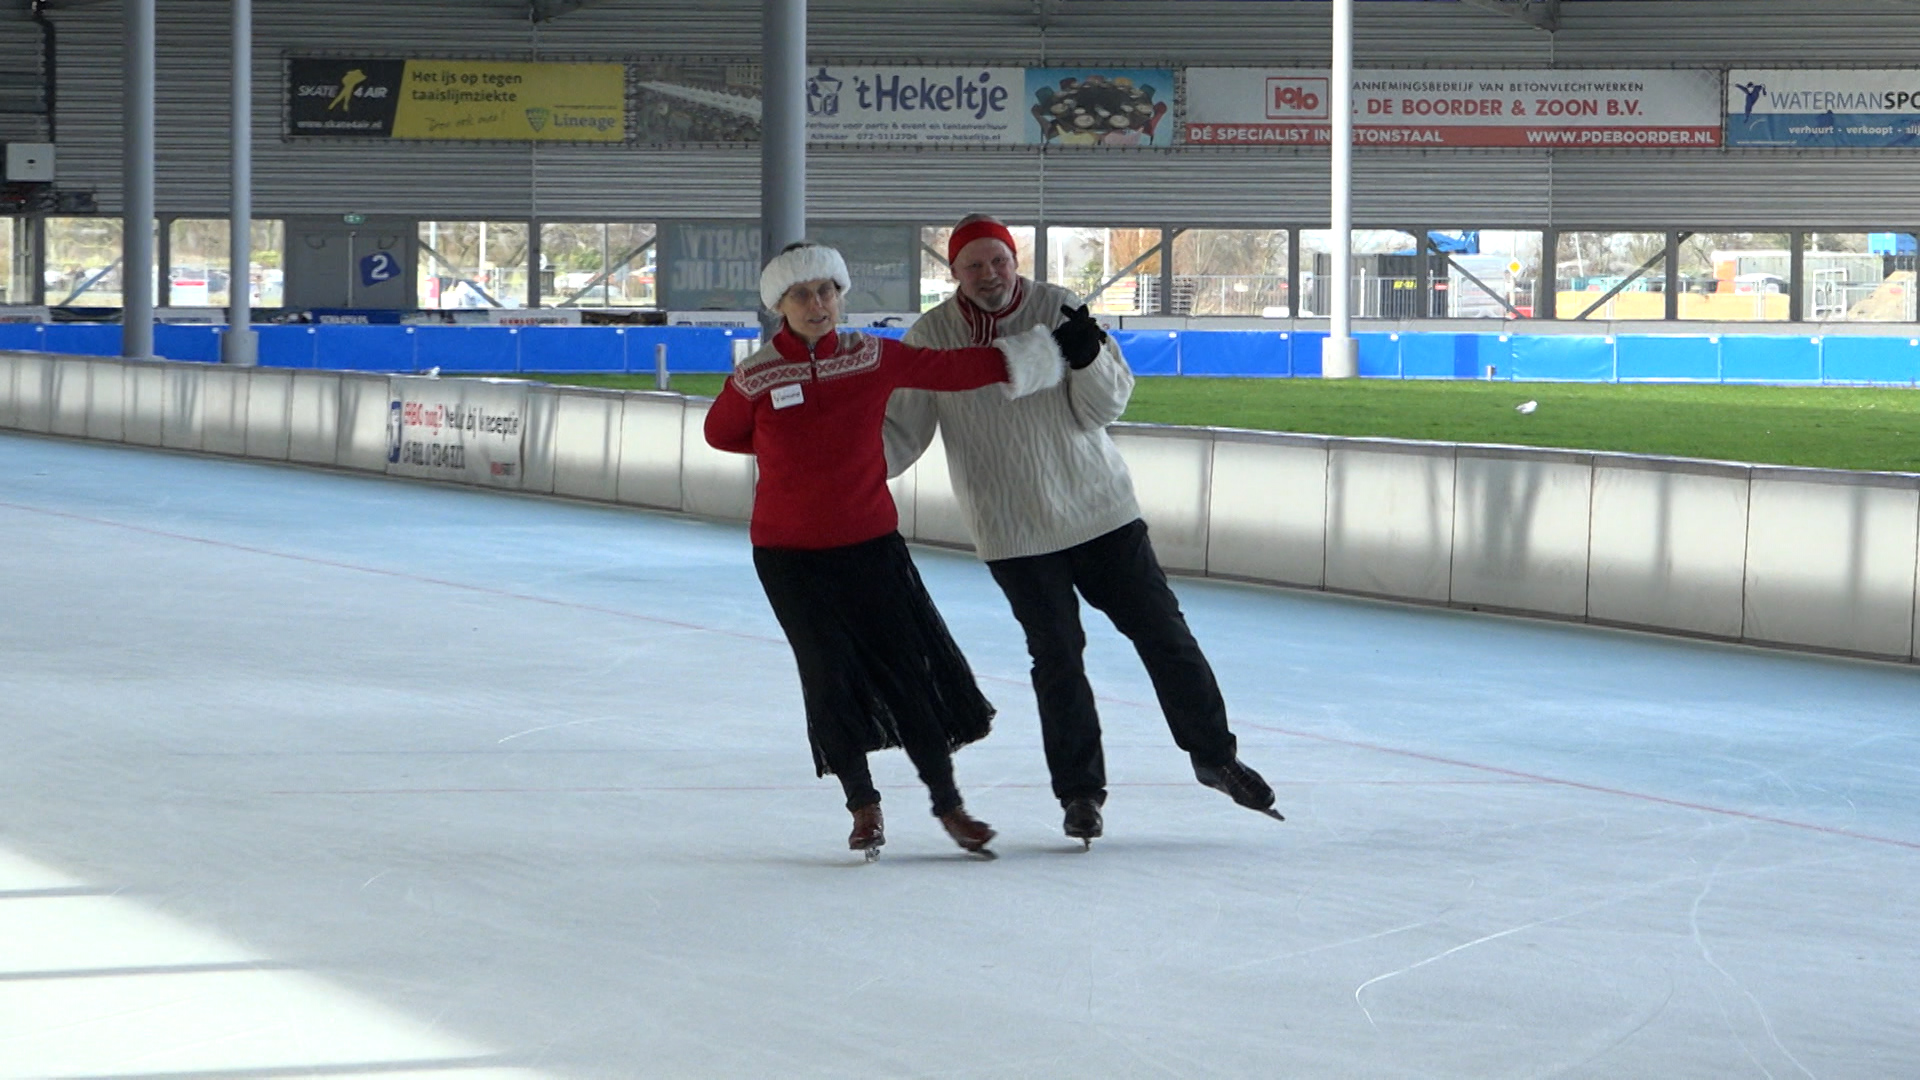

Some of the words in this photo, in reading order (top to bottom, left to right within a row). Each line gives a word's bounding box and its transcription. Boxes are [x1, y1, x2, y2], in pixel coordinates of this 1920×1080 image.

[412, 71, 436, 82] Het
[441, 71, 457, 86] ijs
[460, 73, 478, 85] op
[482, 72, 522, 88] tegen
[1352, 81, 1474, 92] ANNEMINGSBEDRIJF
[1479, 82, 1504, 92] VAN
[1509, 82, 1644, 92] BETONVLECHTWERKEN
[297, 85, 339, 98] SKATE
[353, 86, 364, 98] 4
[364, 86, 389, 98] AIR
[411, 89, 517, 104] taaislijmziekte
[1367, 99, 1393, 115] DE
[1402, 99, 1503, 115] BOORDER
[1511, 99, 1526, 115] &
[1535, 99, 1598, 116] ZOON
[1606, 99, 1643, 116] B.V.
[553, 113, 616, 132] Lineage
[1191, 125, 1213, 141] DÉ
[1216, 128, 1310, 141] SPECIALIST
[1526, 130, 1715, 144] WWW.PDEBOORDER.NL
[1788, 125, 1834, 135] verhuurt
[1845, 125, 1893, 136] verkoopt
[371, 254, 390, 280] 2
